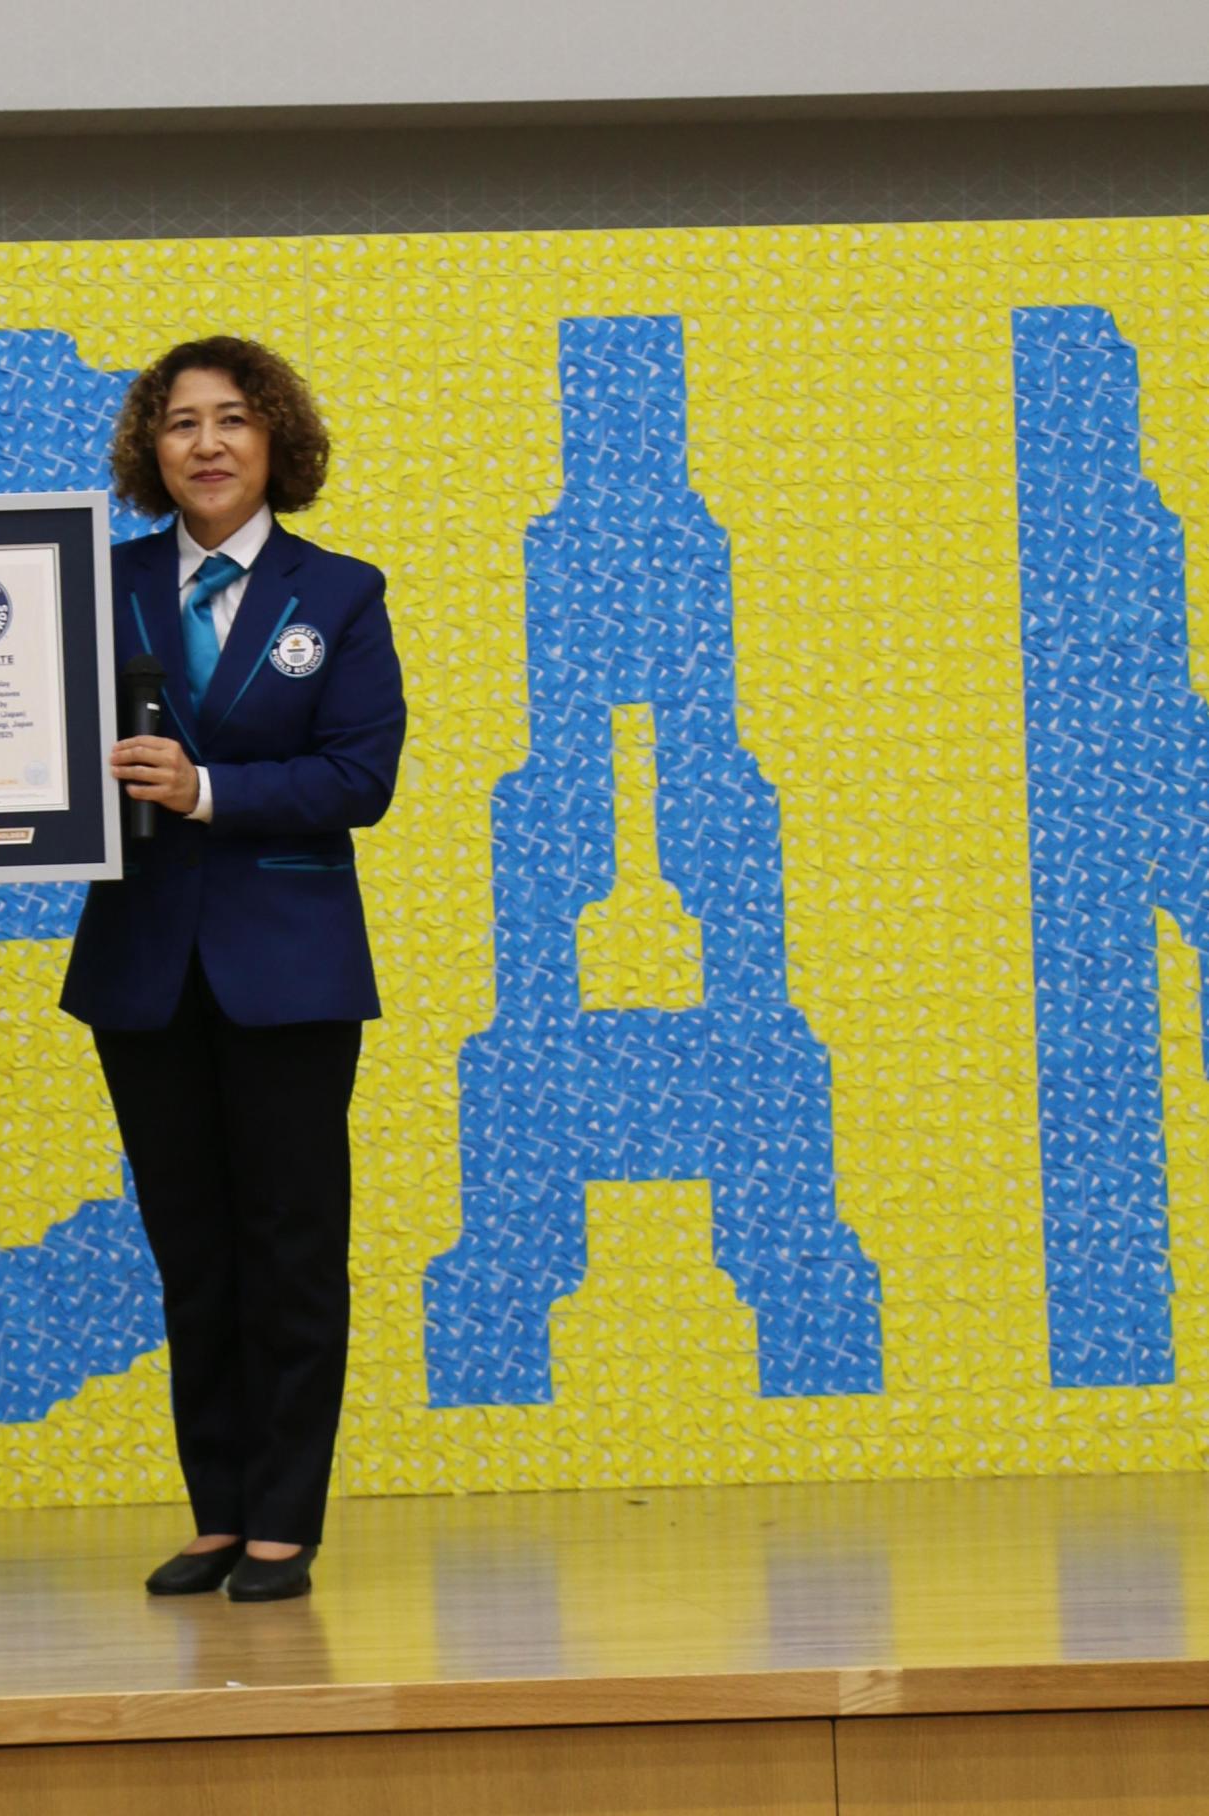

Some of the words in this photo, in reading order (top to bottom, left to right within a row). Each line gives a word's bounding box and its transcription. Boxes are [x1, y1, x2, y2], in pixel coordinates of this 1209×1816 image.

[293, 644, 321, 673] RECORDS
[0, 702, 7, 710] by
[0, 711, 26, 719] (Japan)
[12, 721, 33, 729] Japan
